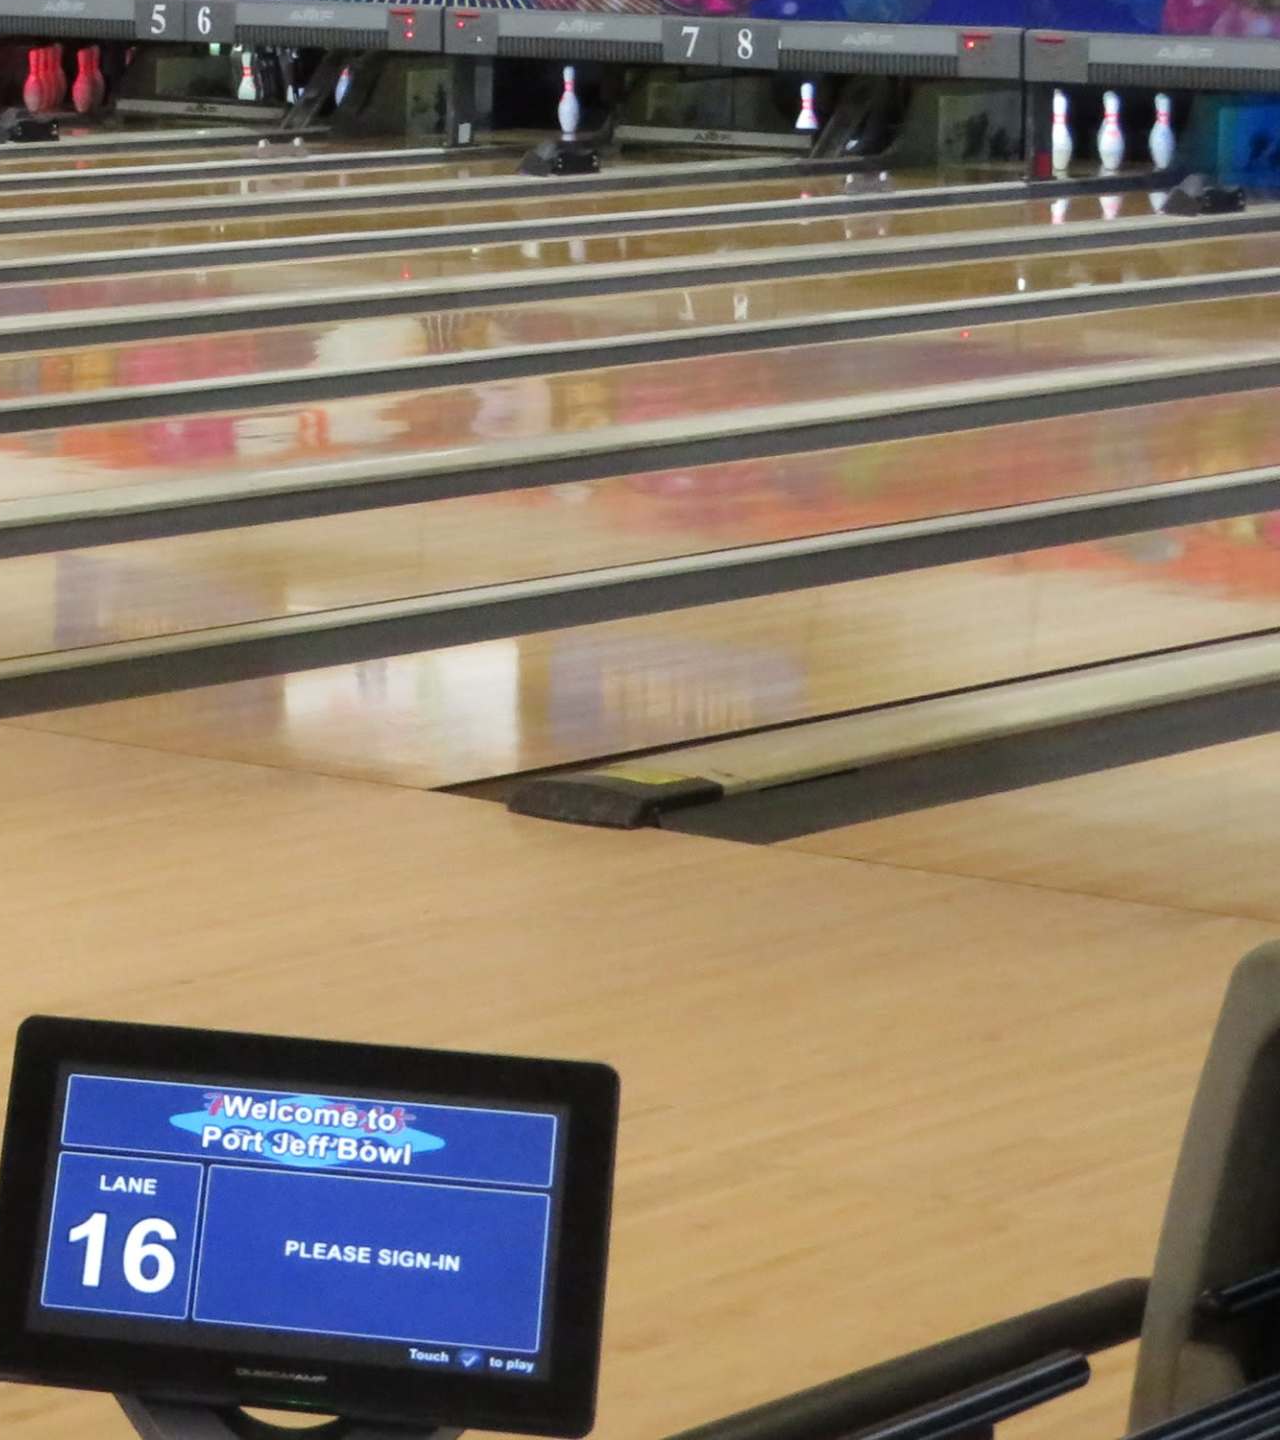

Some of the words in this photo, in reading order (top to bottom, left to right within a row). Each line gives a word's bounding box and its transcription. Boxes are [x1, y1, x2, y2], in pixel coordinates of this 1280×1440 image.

[150, 4, 167, 35] 5
[196, 6, 212, 35] 6
[680, 25, 701, 58] 7
[736, 27, 754, 60] 8
[223, 1094, 358, 1130] Welcome
[364, 1108, 397, 1133] to
[201, 1125, 263, 1156] Port
[271, 1131, 332, 1161] Jeff
[337, 1136, 413, 1167] Bowl
[99, 1173, 158, 1197] LANE
[67, 1211, 179, 1295] 16
[284, 1239, 372, 1266] PLEASE
[377, 1247, 461, 1273] SIGN-IN
[408, 1347, 450, 1364] Touch
[489, 1355, 504, 1369] to
[506, 1357, 536, 1376] play
